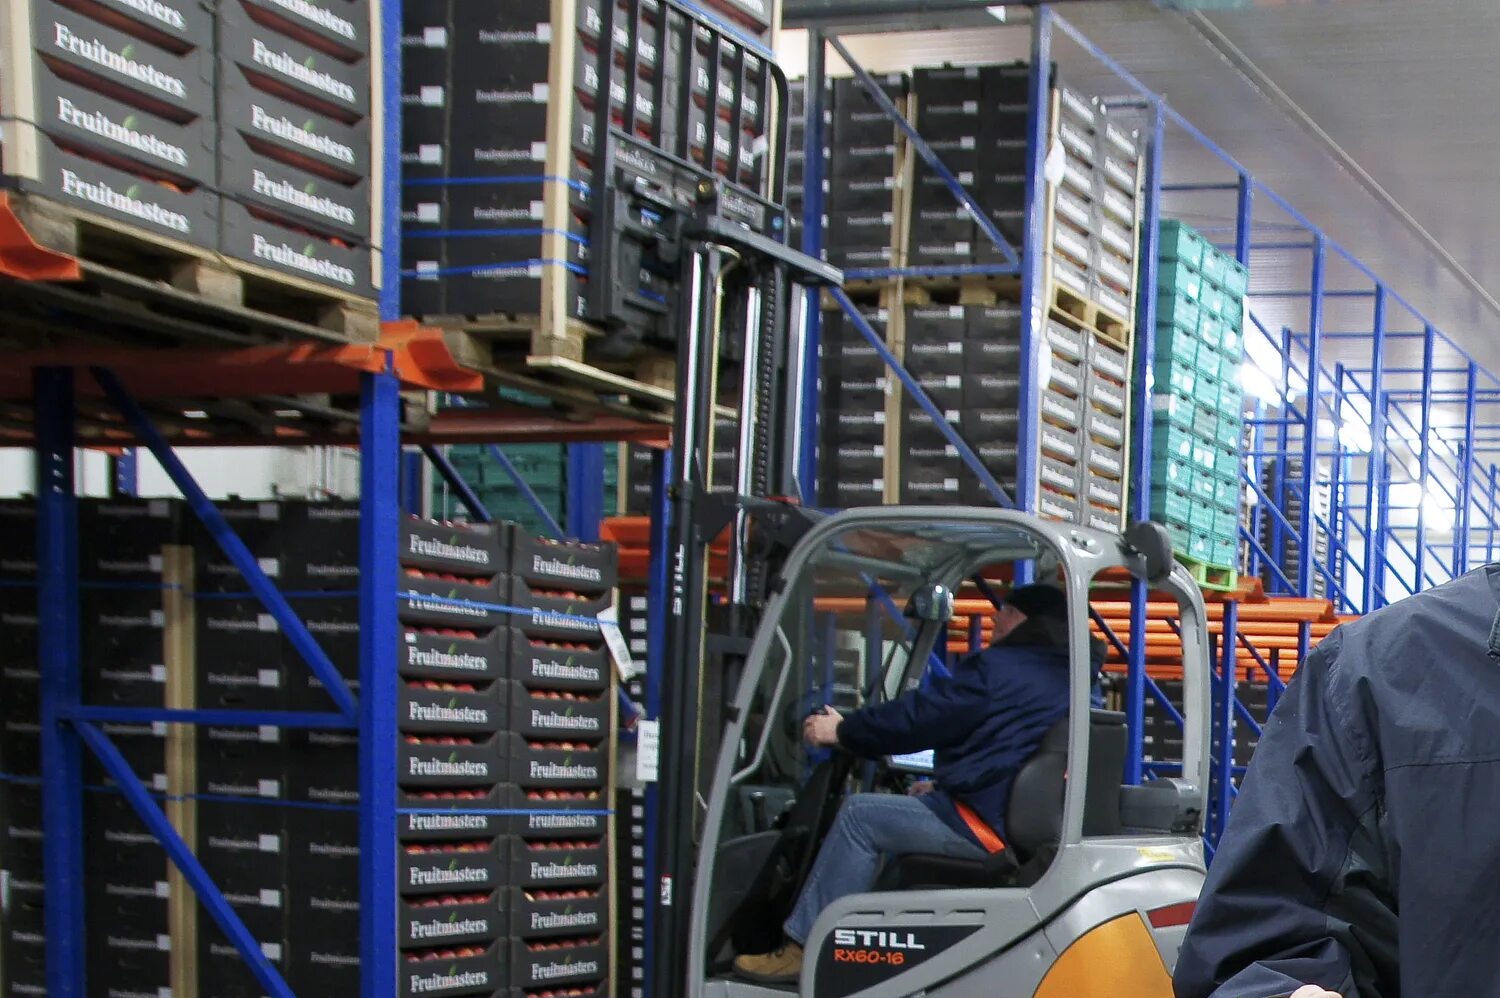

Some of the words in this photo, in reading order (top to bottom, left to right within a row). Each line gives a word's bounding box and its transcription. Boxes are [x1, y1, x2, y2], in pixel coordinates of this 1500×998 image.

[54, 21, 187, 98] Fruitmasters
[252, 38, 356, 103] Fruitmasters
[58, 96, 189, 167] Fruitmasters
[251, 104, 355, 164] Fruitmasters
[61, 168, 190, 233] Fruitmasters
[252, 169, 356, 225] Fruitmasters
[252, 233, 356, 286] Fruitmasters
[410, 533, 489, 564] Fruitmasters
[533, 555, 601, 581] Fruitmasters
[408, 646, 487, 670] Fruitmasters
[532, 658, 599, 680] Fruitmasters
[408, 701, 488, 723] Fruitmasters
[531, 709, 598, 729] Fruitmasters
[409, 756, 488, 776] Fruitmasters
[530, 760, 597, 778] Fruitmasters
[408, 812, 488, 830] Fruitmasters
[409, 866, 488, 885] Fruitmasters
[531, 861, 597, 878] Fruitmasters
[410, 917, 488, 938] Fruitmasters
[531, 911, 597, 928] Fruitmasters
[835, 929, 925, 950] STILL
[834, 949, 904, 965] RX60-16
[410, 970, 488, 992] Fruitmasters
[532, 960, 598, 980] Fruitmasters
